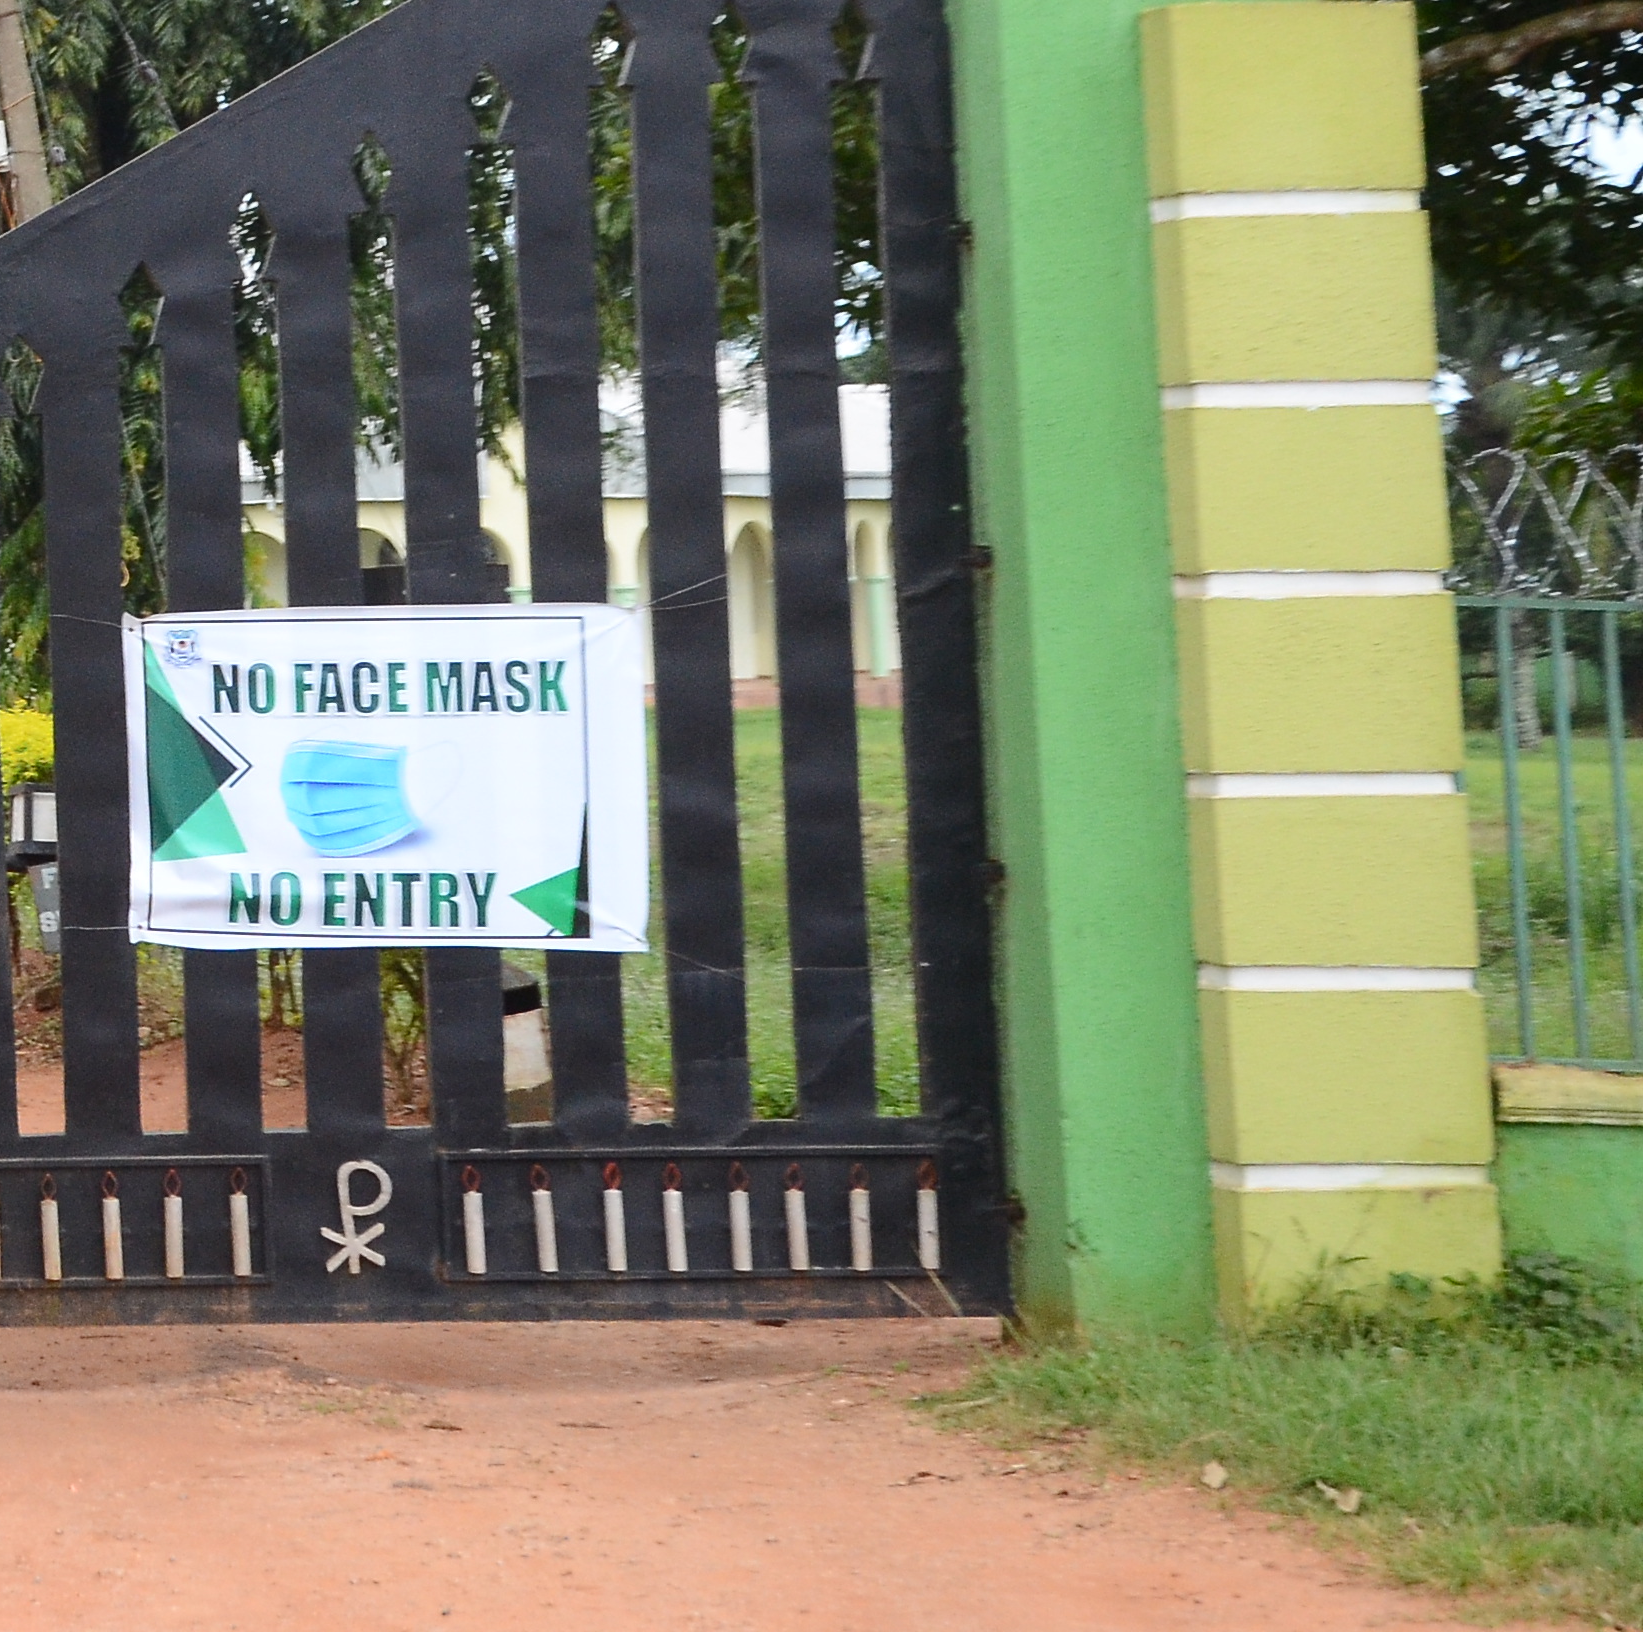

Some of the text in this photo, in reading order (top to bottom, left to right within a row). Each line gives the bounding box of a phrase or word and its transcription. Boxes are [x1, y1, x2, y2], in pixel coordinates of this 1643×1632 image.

[213, 660, 569, 715] NO FACE MASK
[228, 872, 497, 928] NO ENTRY
